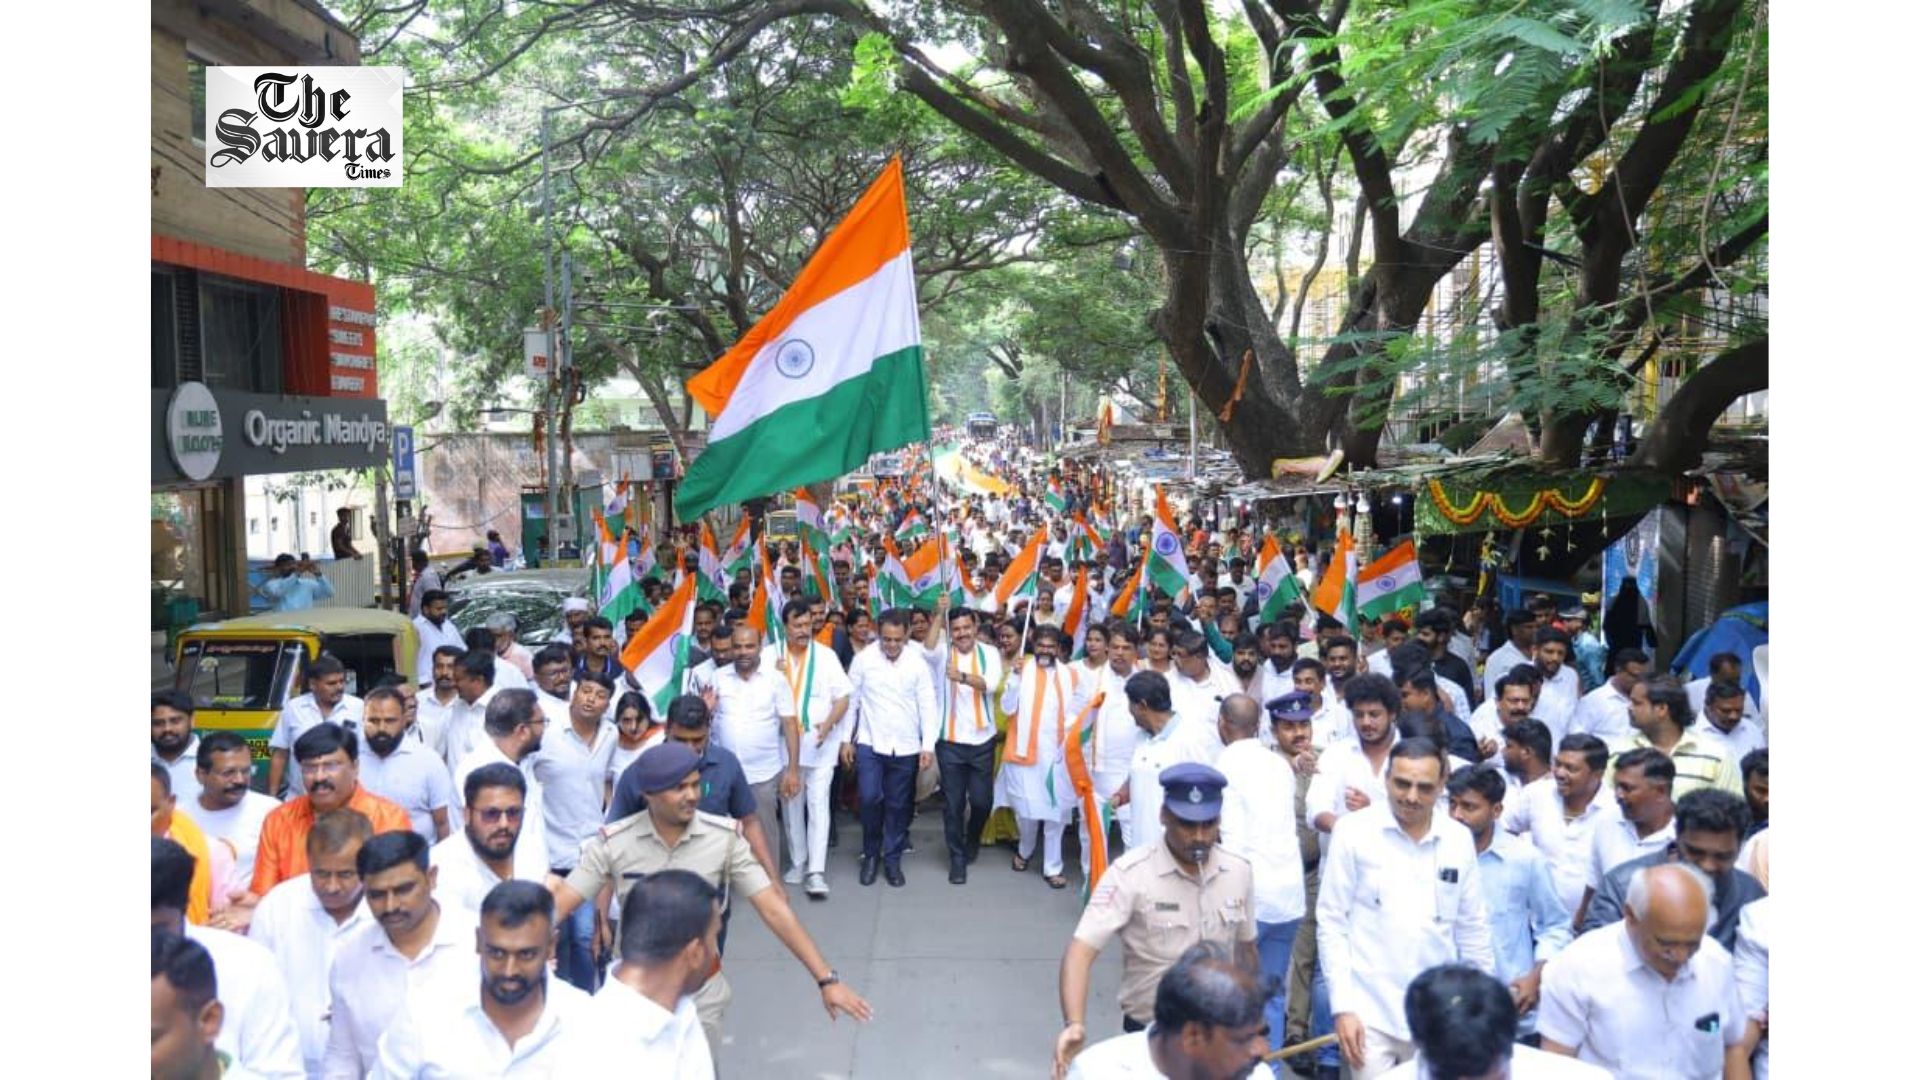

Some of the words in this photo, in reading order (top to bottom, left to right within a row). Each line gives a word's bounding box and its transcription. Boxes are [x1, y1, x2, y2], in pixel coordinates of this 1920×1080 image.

[244, 410, 321, 453] Organic
[323, 413, 385, 452] Mandya
[397, 432, 409, 468] P
